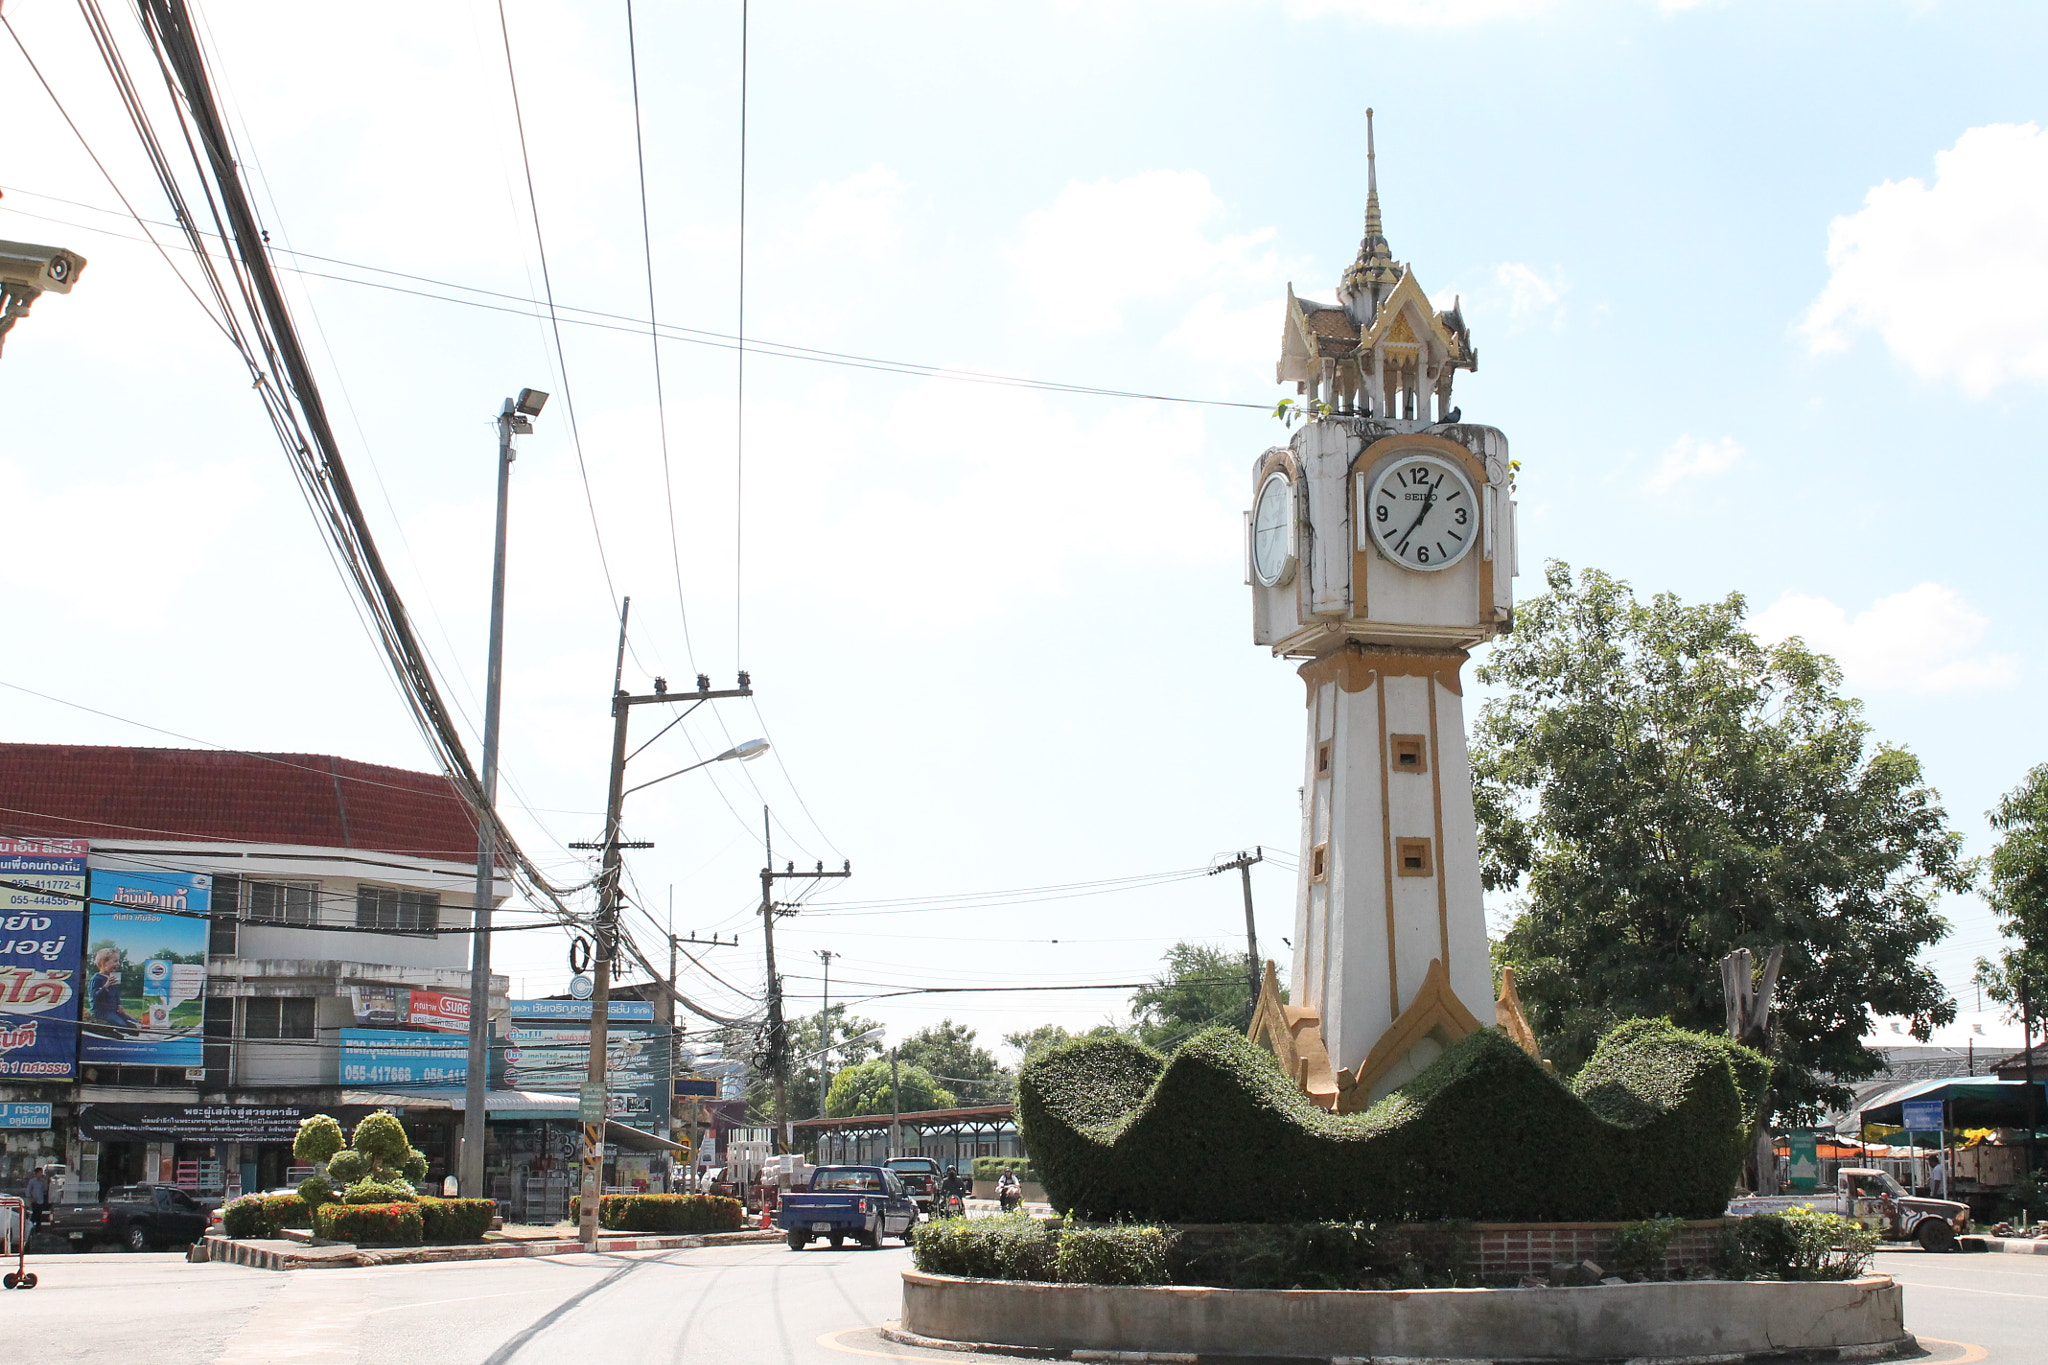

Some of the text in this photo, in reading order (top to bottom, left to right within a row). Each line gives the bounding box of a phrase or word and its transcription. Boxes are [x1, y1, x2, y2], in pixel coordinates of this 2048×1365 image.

[1410, 467, 1429, 484] 12
[1377, 505, 1388, 522] 9
[1455, 508, 1467, 525] 3
[1417, 546, 1429, 562] 6
[15, 1105, 49, 1115] กระจก
